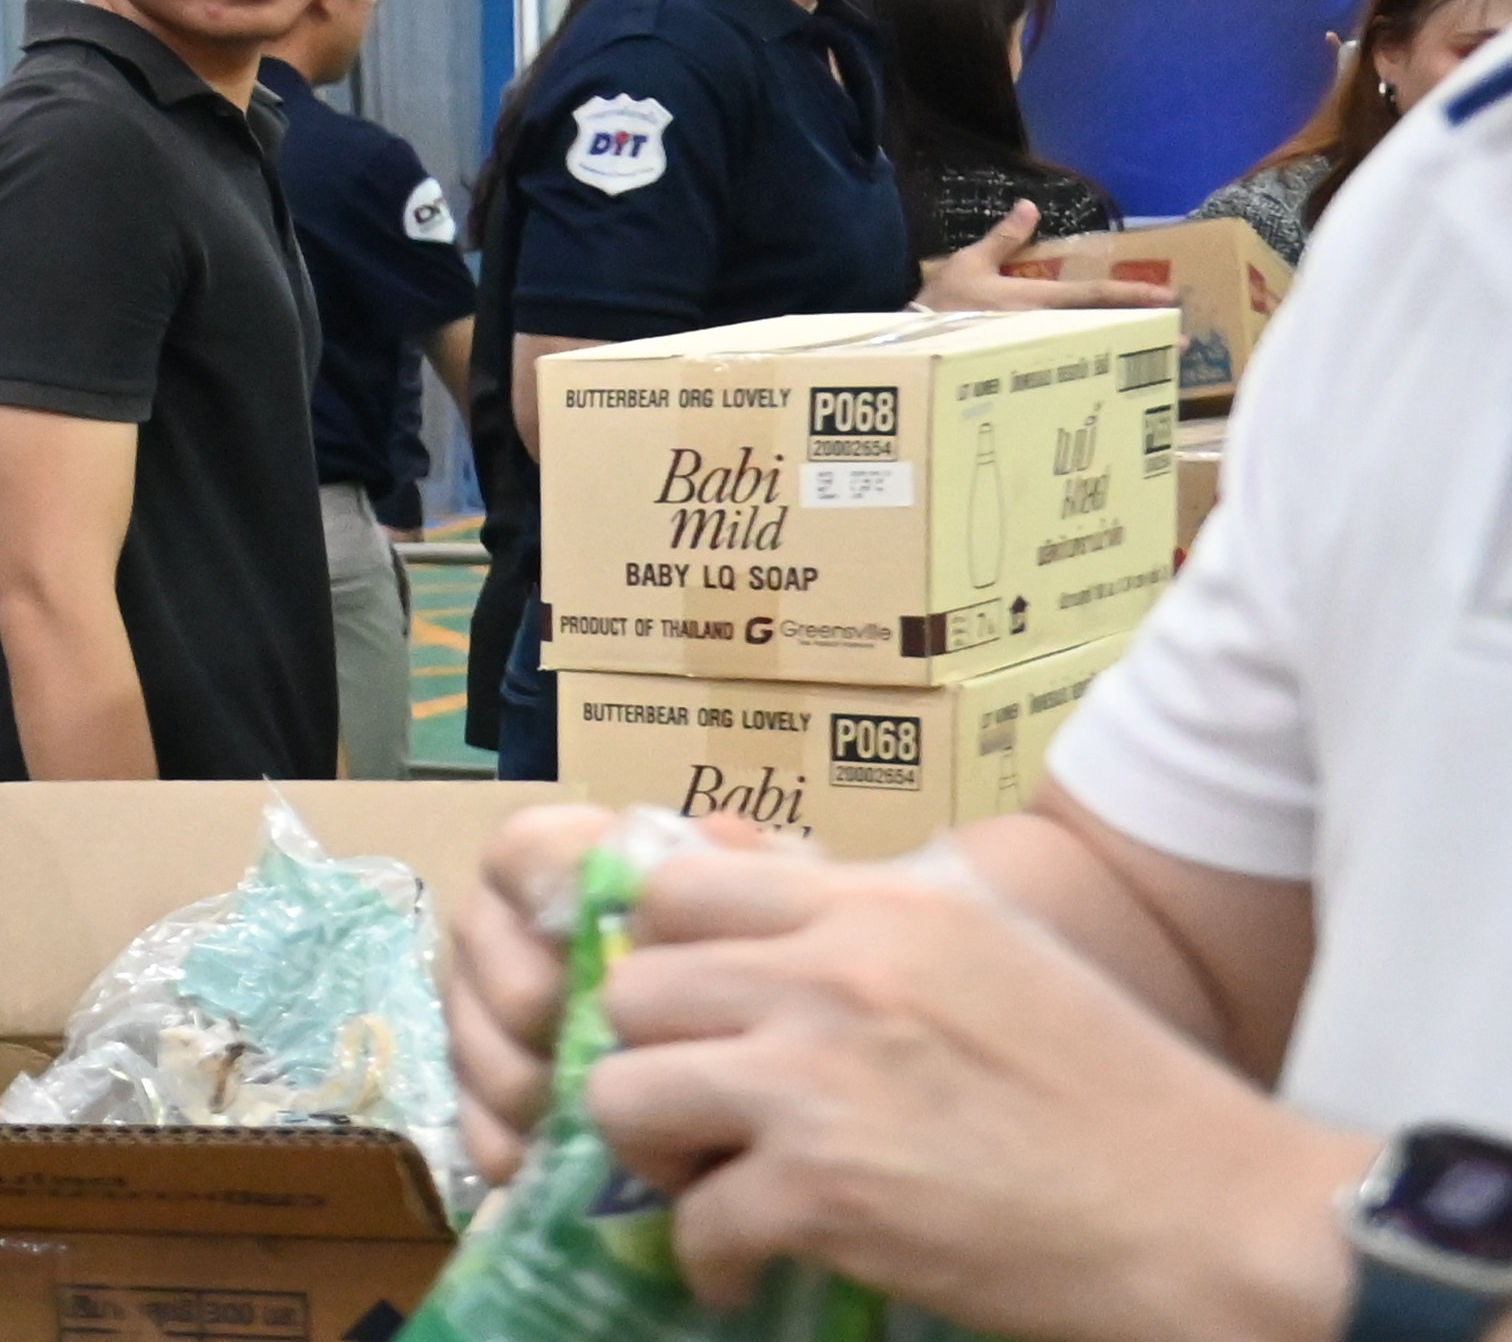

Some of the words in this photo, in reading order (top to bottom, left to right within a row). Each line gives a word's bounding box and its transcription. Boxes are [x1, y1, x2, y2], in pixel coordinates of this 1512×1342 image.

[565, 388, 670, 409] BUTTERBEAR
[678, 388, 714, 408] ORG
[722, 388, 792, 409] LOVELY
[814, 392, 896, 433] P068
[813, 440, 893, 457] 20002654
[653, 446, 785, 506] Babi
[626, 562, 691, 589] BABY
[703, 564, 736, 591] LQ
[748, 566, 820, 592] SOAP
[560, 615, 628, 637] PRODUCT
[635, 618, 655, 638] OF
[661, 618, 735, 641] THAILAND
[780, 619, 893, 643] Greensville
[582, 701, 690, 727] BUTTERBEAR
[697, 706, 734, 730] ORG
[741, 709, 812, 734] LOVELY
[835, 719, 920, 763] P068
[834, 764, 916, 786] 20002654
[678, 763, 809, 825] Babi
